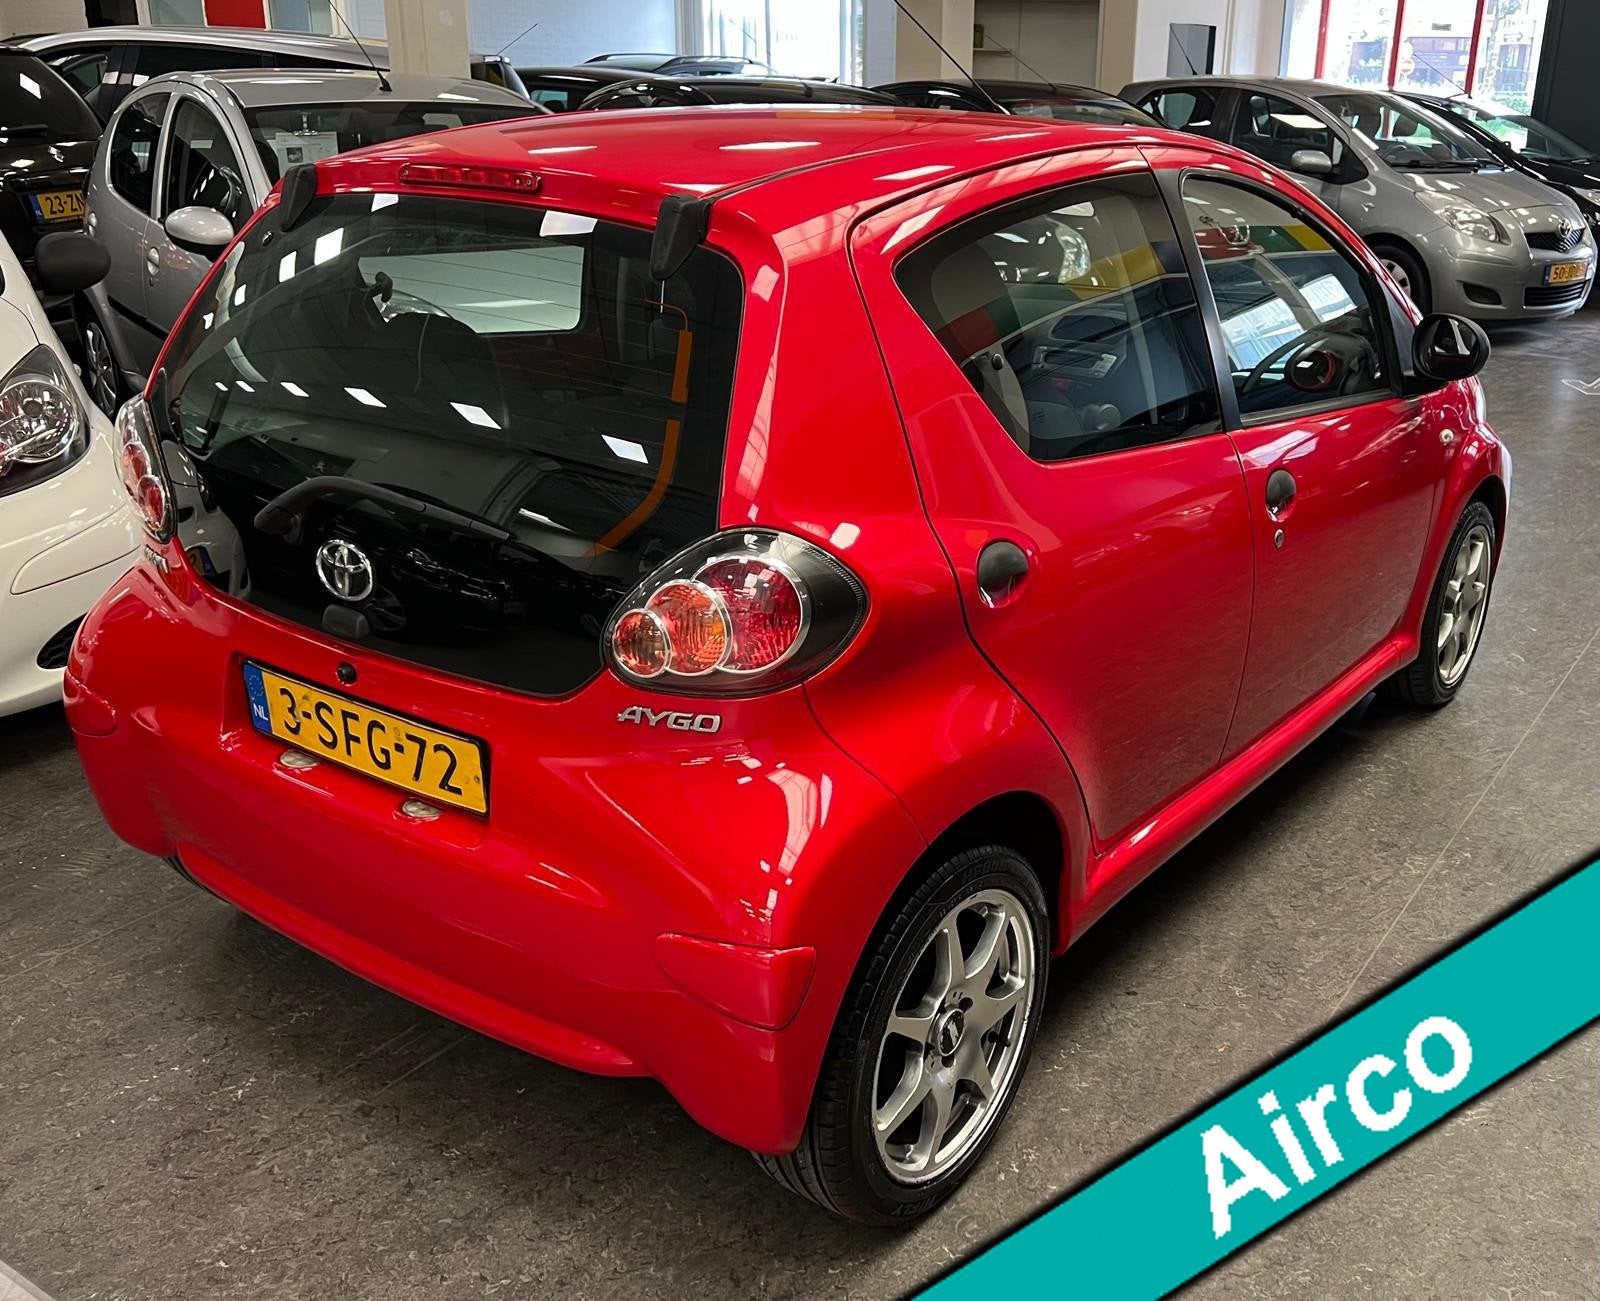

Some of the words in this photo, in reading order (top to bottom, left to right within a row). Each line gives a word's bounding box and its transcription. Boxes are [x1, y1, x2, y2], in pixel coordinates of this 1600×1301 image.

[253, 702, 269, 721] NL
[617, 705, 721, 733] AYGO
[279, 687, 463, 796] 3-SFG-72
